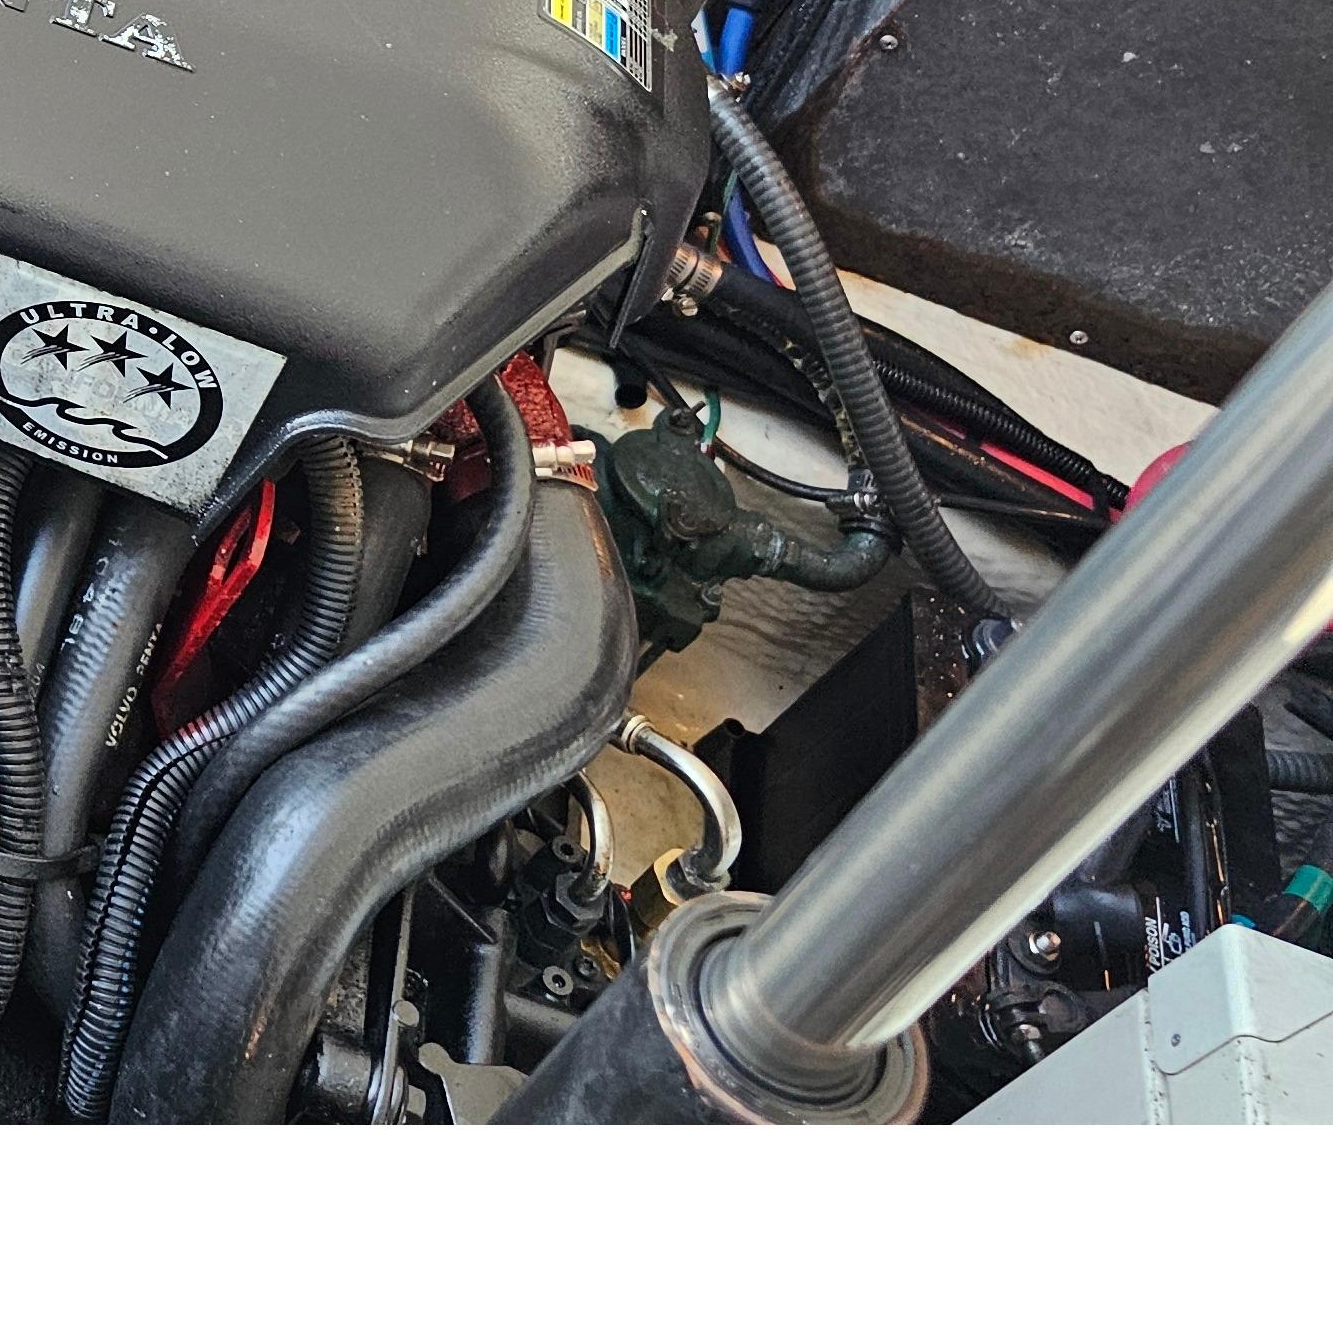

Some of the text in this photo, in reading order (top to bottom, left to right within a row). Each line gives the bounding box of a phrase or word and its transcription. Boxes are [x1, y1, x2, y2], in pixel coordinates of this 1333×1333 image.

[19, 303, 218, 389] ULTRA LOW
[22, 422, 119, 464] EMISSION
[105, 686, 138, 748] VOLVO
